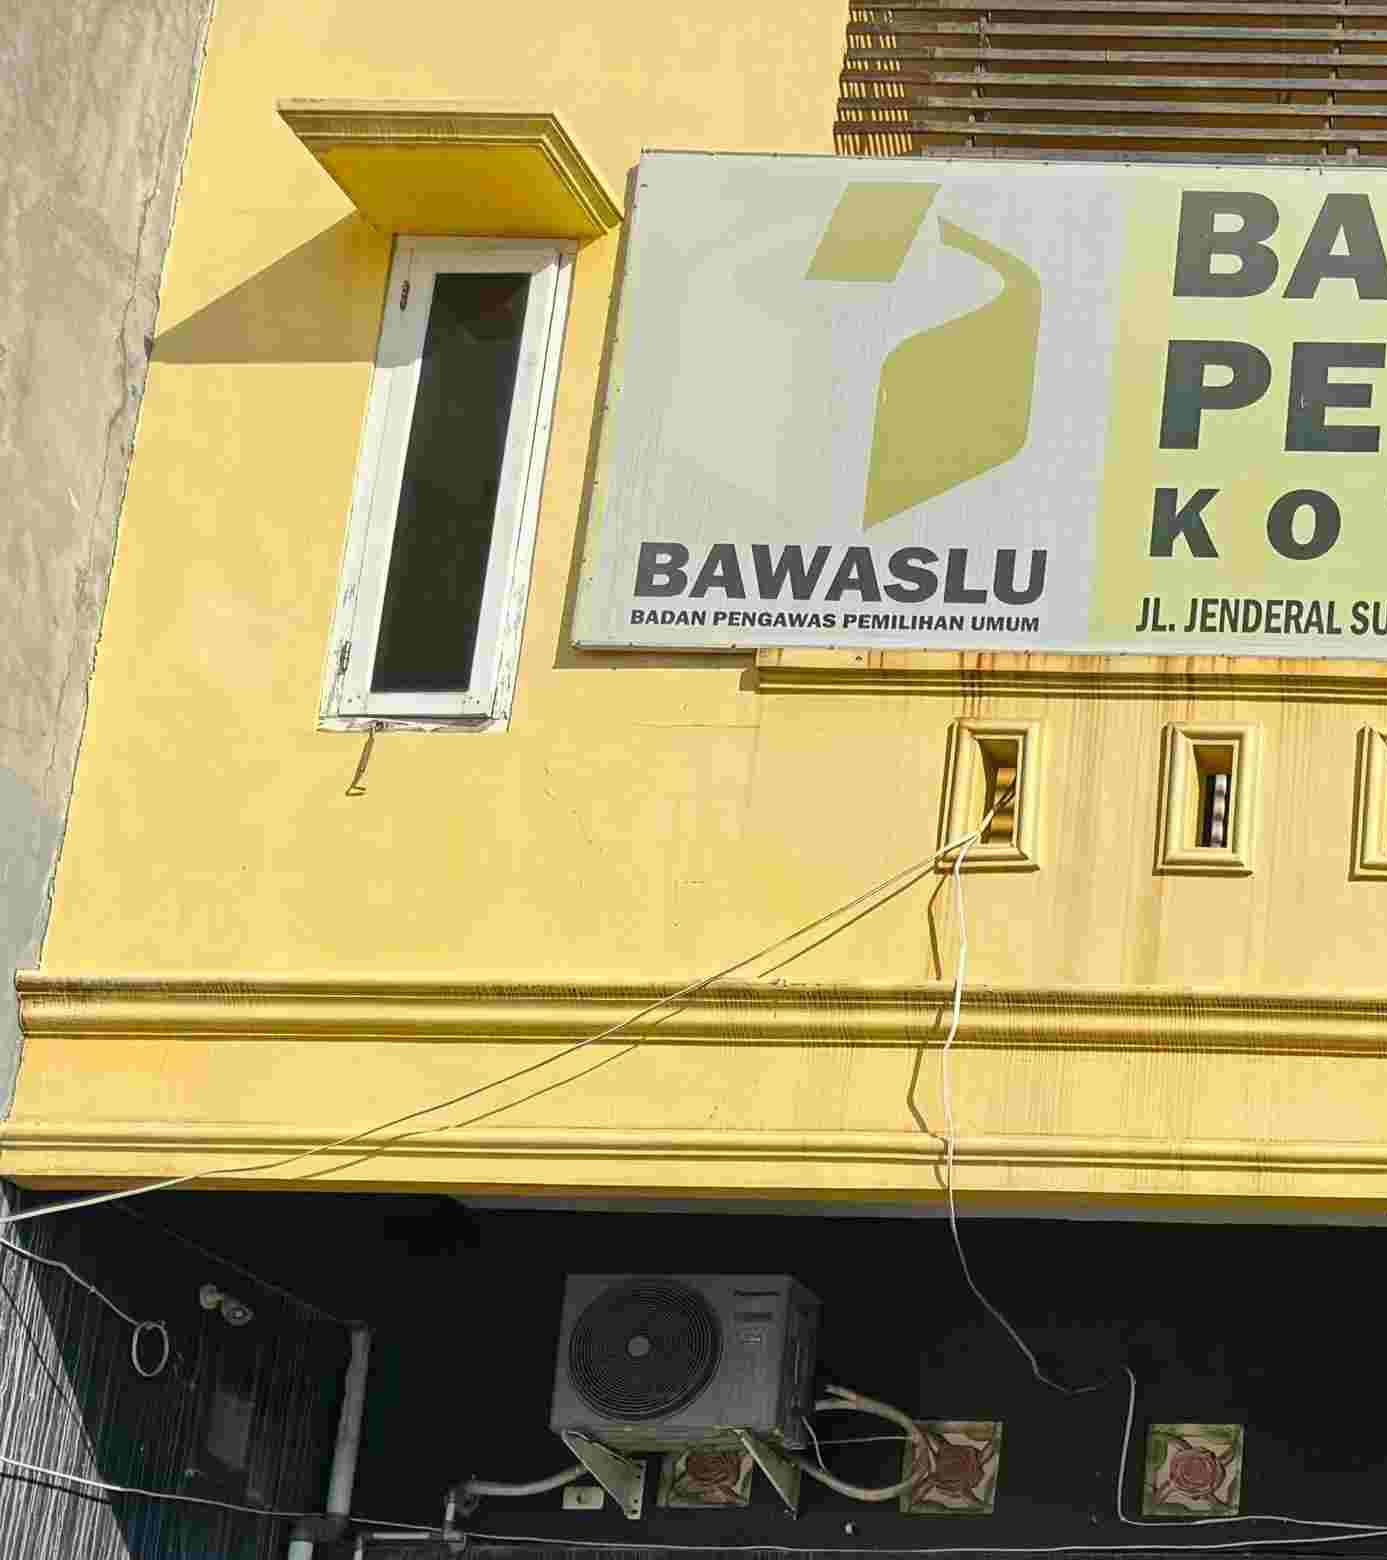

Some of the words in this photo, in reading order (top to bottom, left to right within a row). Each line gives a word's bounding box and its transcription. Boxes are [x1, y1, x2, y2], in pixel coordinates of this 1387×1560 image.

[634, 541, 1048, 605] BAWASLU
[630, 609, 707, 626] BADAN
[712, 611, 837, 629] PENGAWAS
[842, 613, 964, 631] PEMILIHAN
[971, 615, 1040, 633] UMUM
[1135, 597, 1175, 632] JL.
[1184, 598, 1342, 634] JENDERAL
